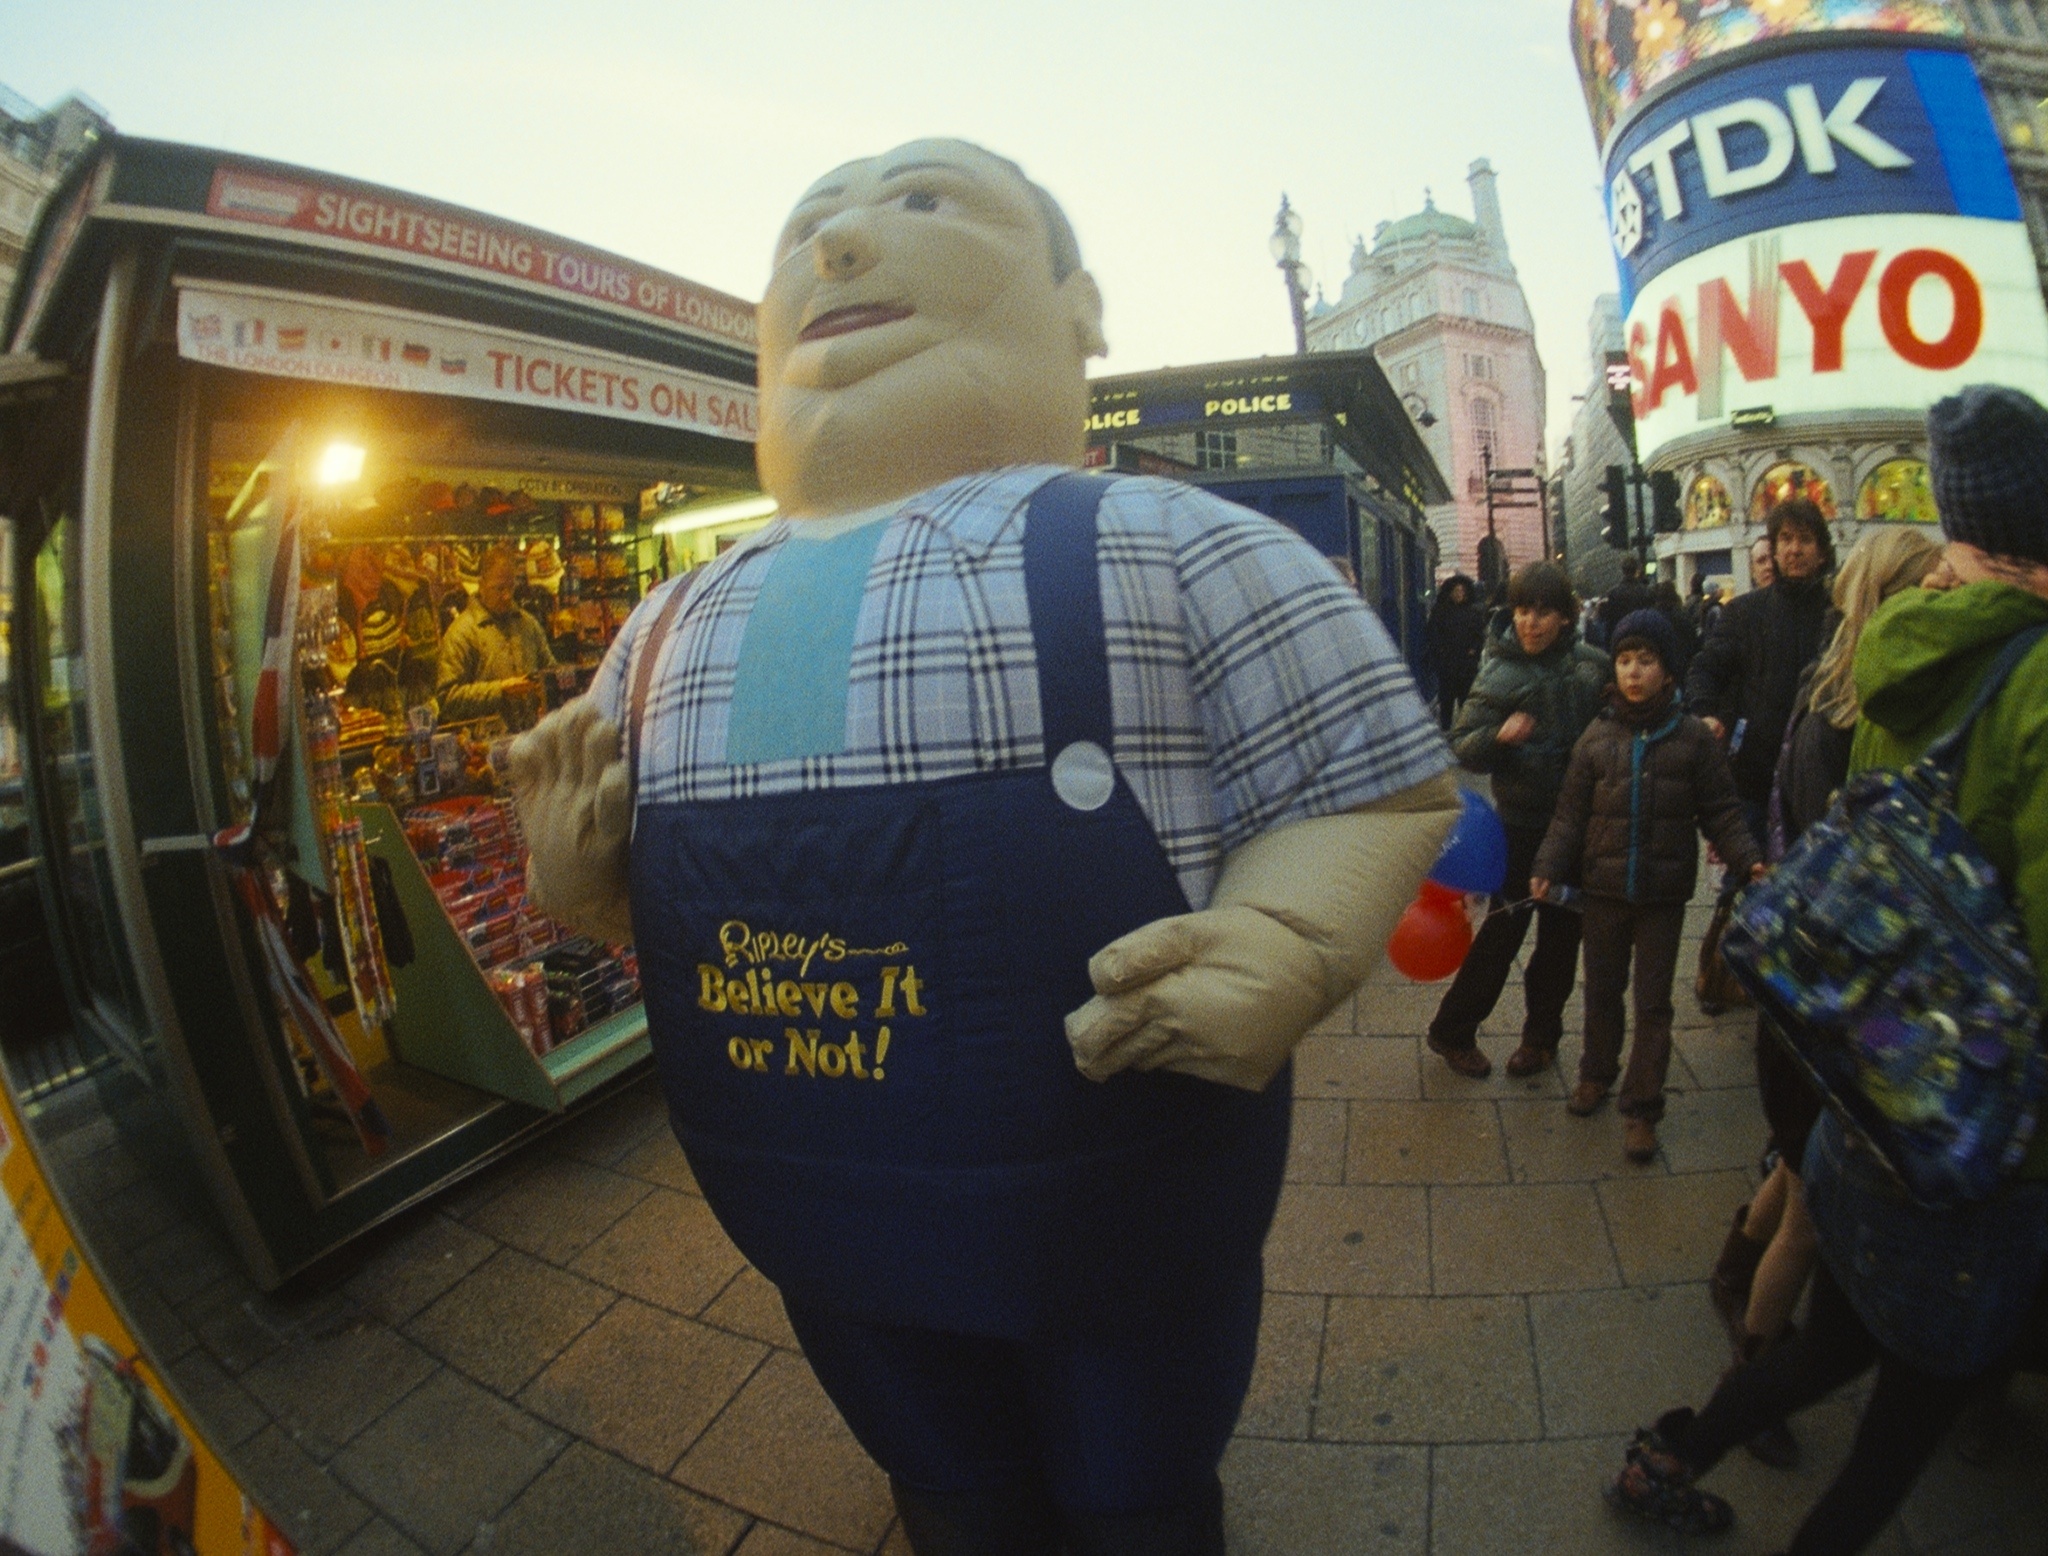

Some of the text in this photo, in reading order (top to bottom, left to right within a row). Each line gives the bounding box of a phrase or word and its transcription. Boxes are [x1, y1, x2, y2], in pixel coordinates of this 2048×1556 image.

[1628, 76, 1915, 222] TDK
[315, 193, 533, 275] SIGHTSEEING
[540, 250, 631, 300] TOURS
[637, 280, 669, 311] OF
[1626, 248, 1985, 421] SANYO
[486, 350, 760, 433] TICKETS ON SAL
[1083, 408, 1141, 432] OLICE
[1205, 394, 1292, 416] POLICE
[698, 963, 927, 1019] Believe It
[728, 1026, 891, 1080] or Not!
